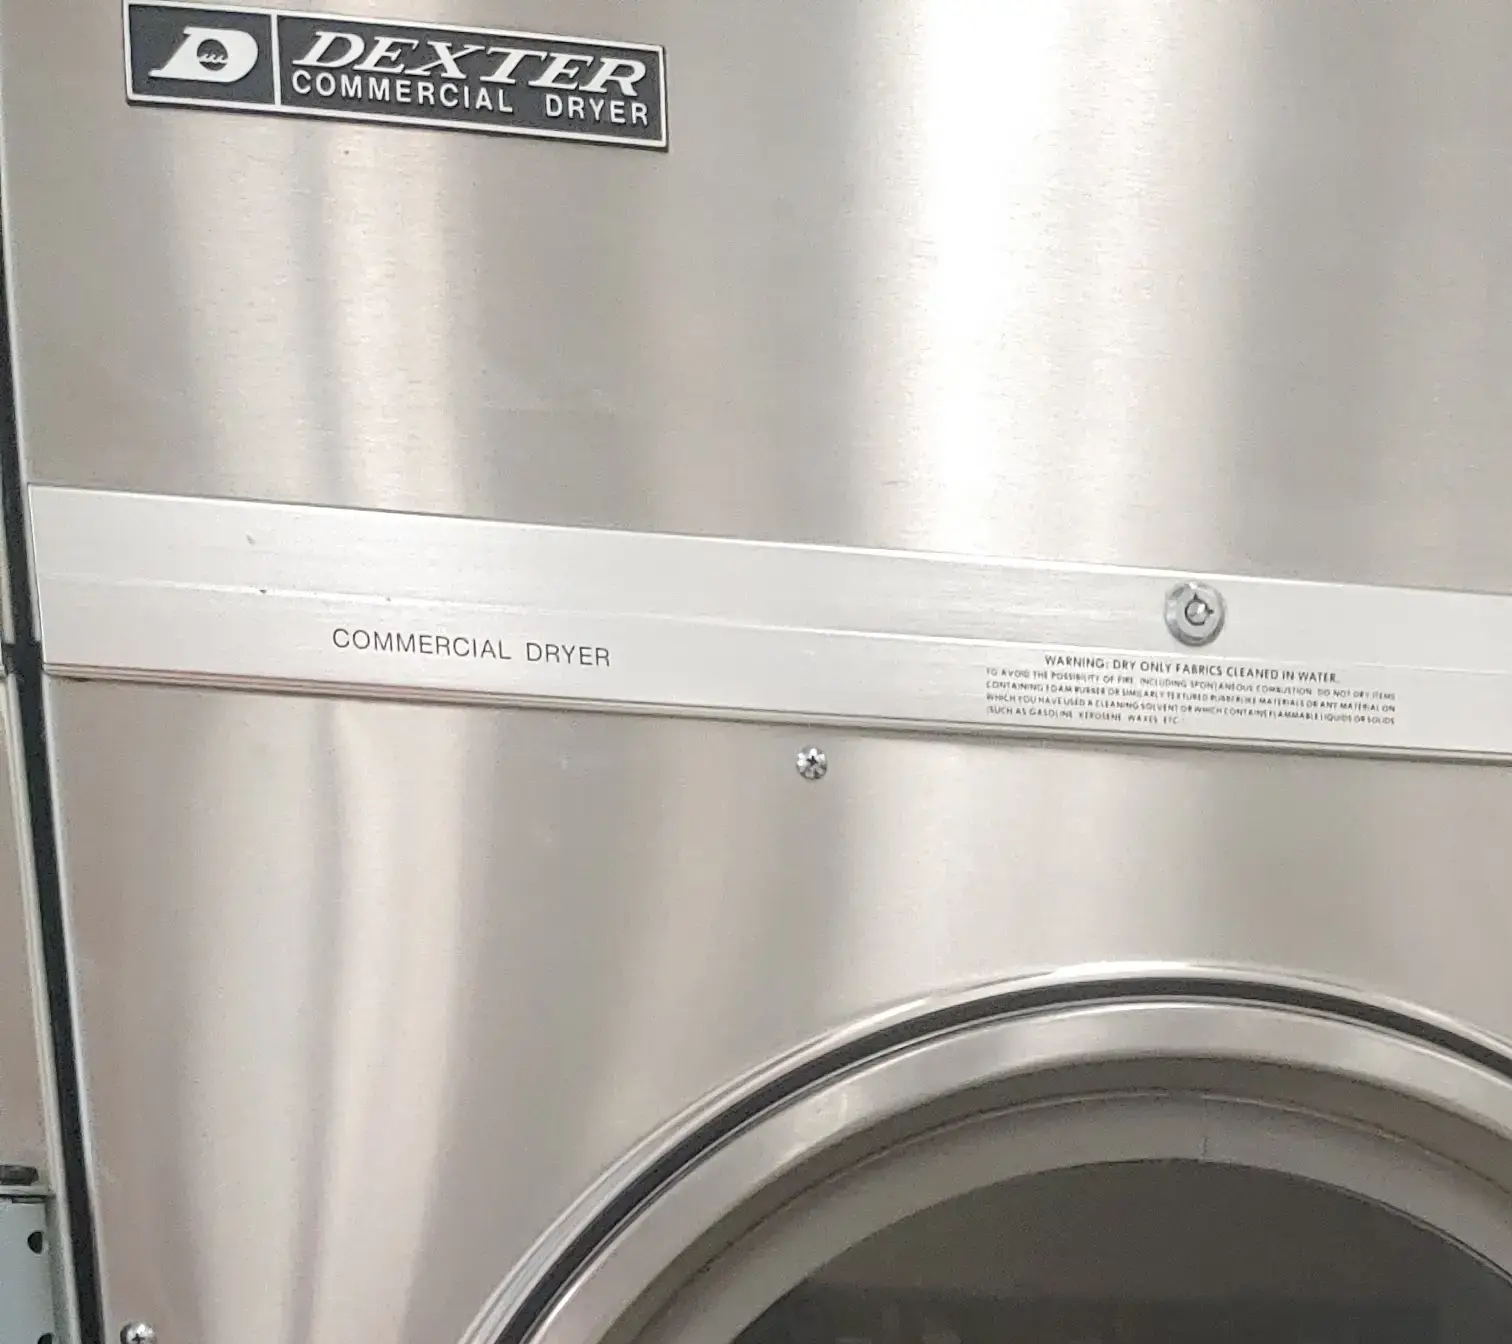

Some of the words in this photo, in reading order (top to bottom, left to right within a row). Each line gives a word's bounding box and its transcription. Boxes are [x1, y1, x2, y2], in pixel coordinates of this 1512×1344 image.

[292, 31, 647, 96] DEXTER
[292, 69, 513, 113] COMMERCIAL
[546, 94, 648, 125] DRYER
[332, 628, 512, 660] COMMERCIAL
[526, 642, 610, 667] DRYER
[1001, 669, 1029, 678] AVOID
[1033, 670, 1048, 679] THE
[1045, 655, 1109, 669] WARNING:
[1113, 659, 1136, 671] DRY
[1140, 661, 1172, 674] ONLY
[1175, 663, 1222, 676] FABRICS
[1226, 666, 1278, 680] CLEANED
[1282, 670, 1295, 681] IN
